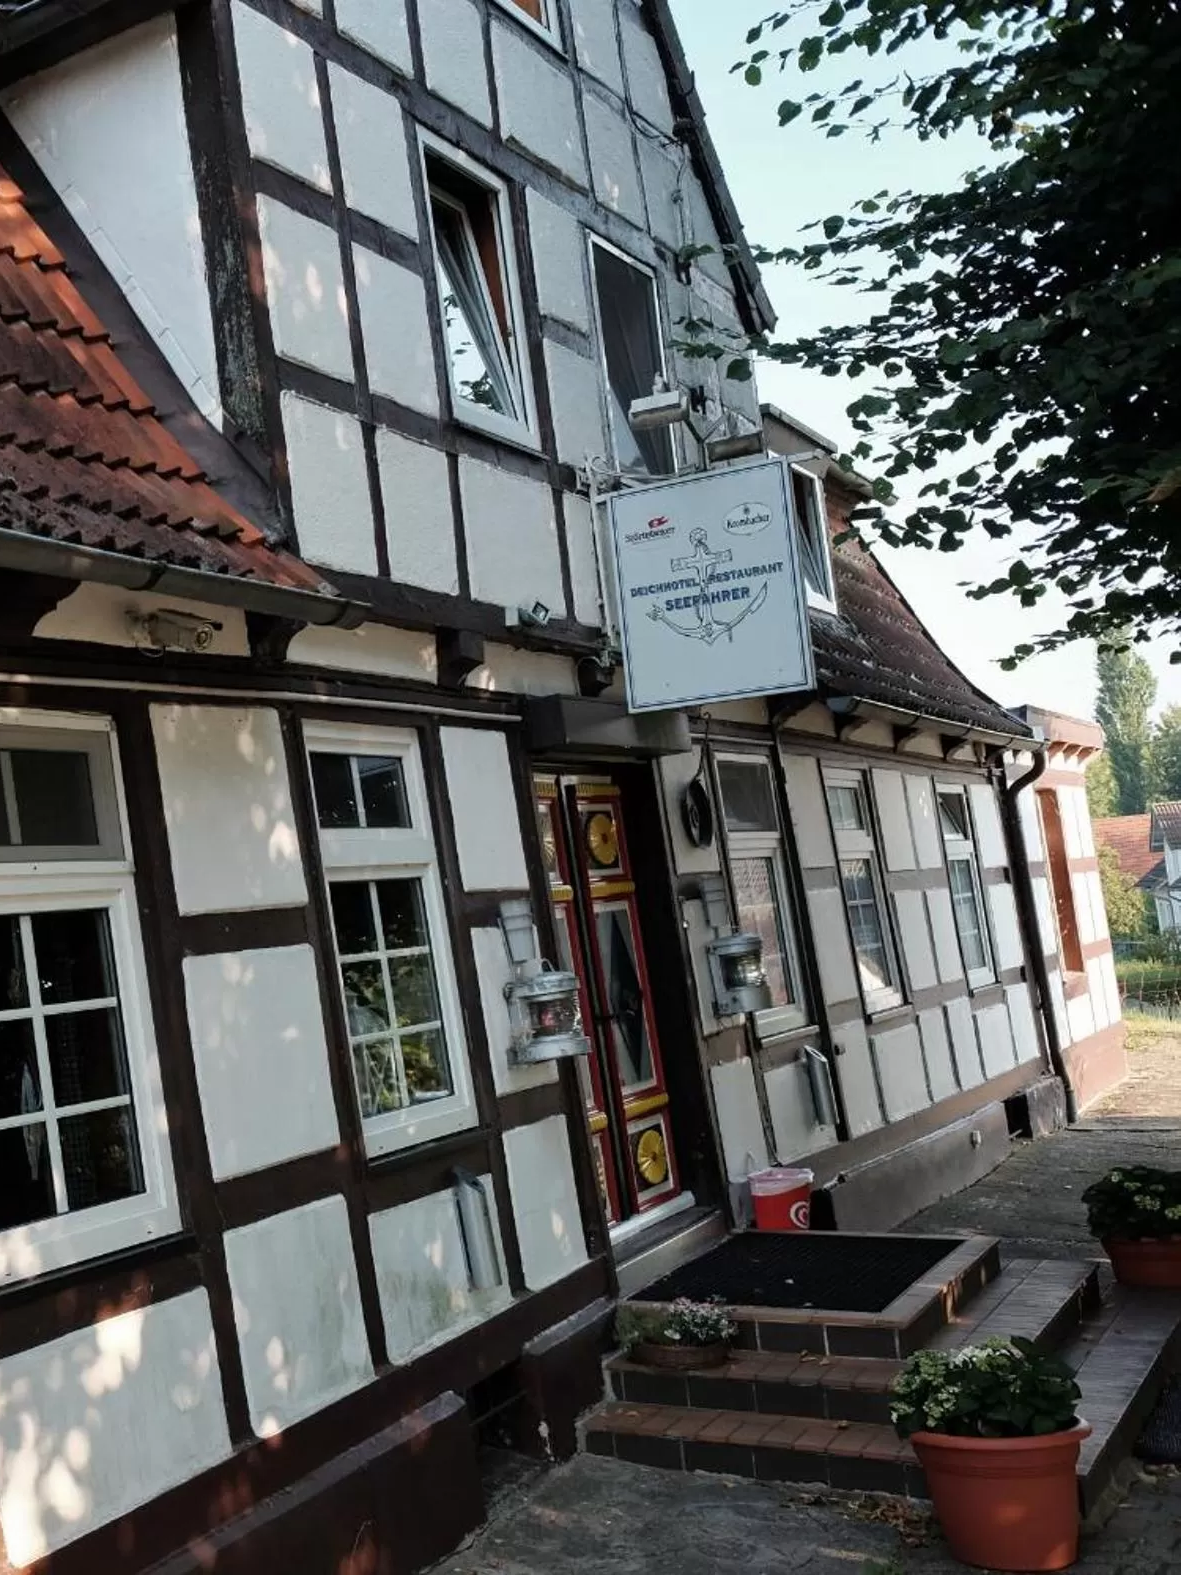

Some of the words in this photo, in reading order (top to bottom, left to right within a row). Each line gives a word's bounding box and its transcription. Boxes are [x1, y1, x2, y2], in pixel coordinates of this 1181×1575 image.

[630, 578, 700, 598] DEICHHOTEL
[707, 562, 784, 584] RESTAURANT
[665, 586, 750, 611] SEEFAHRER
